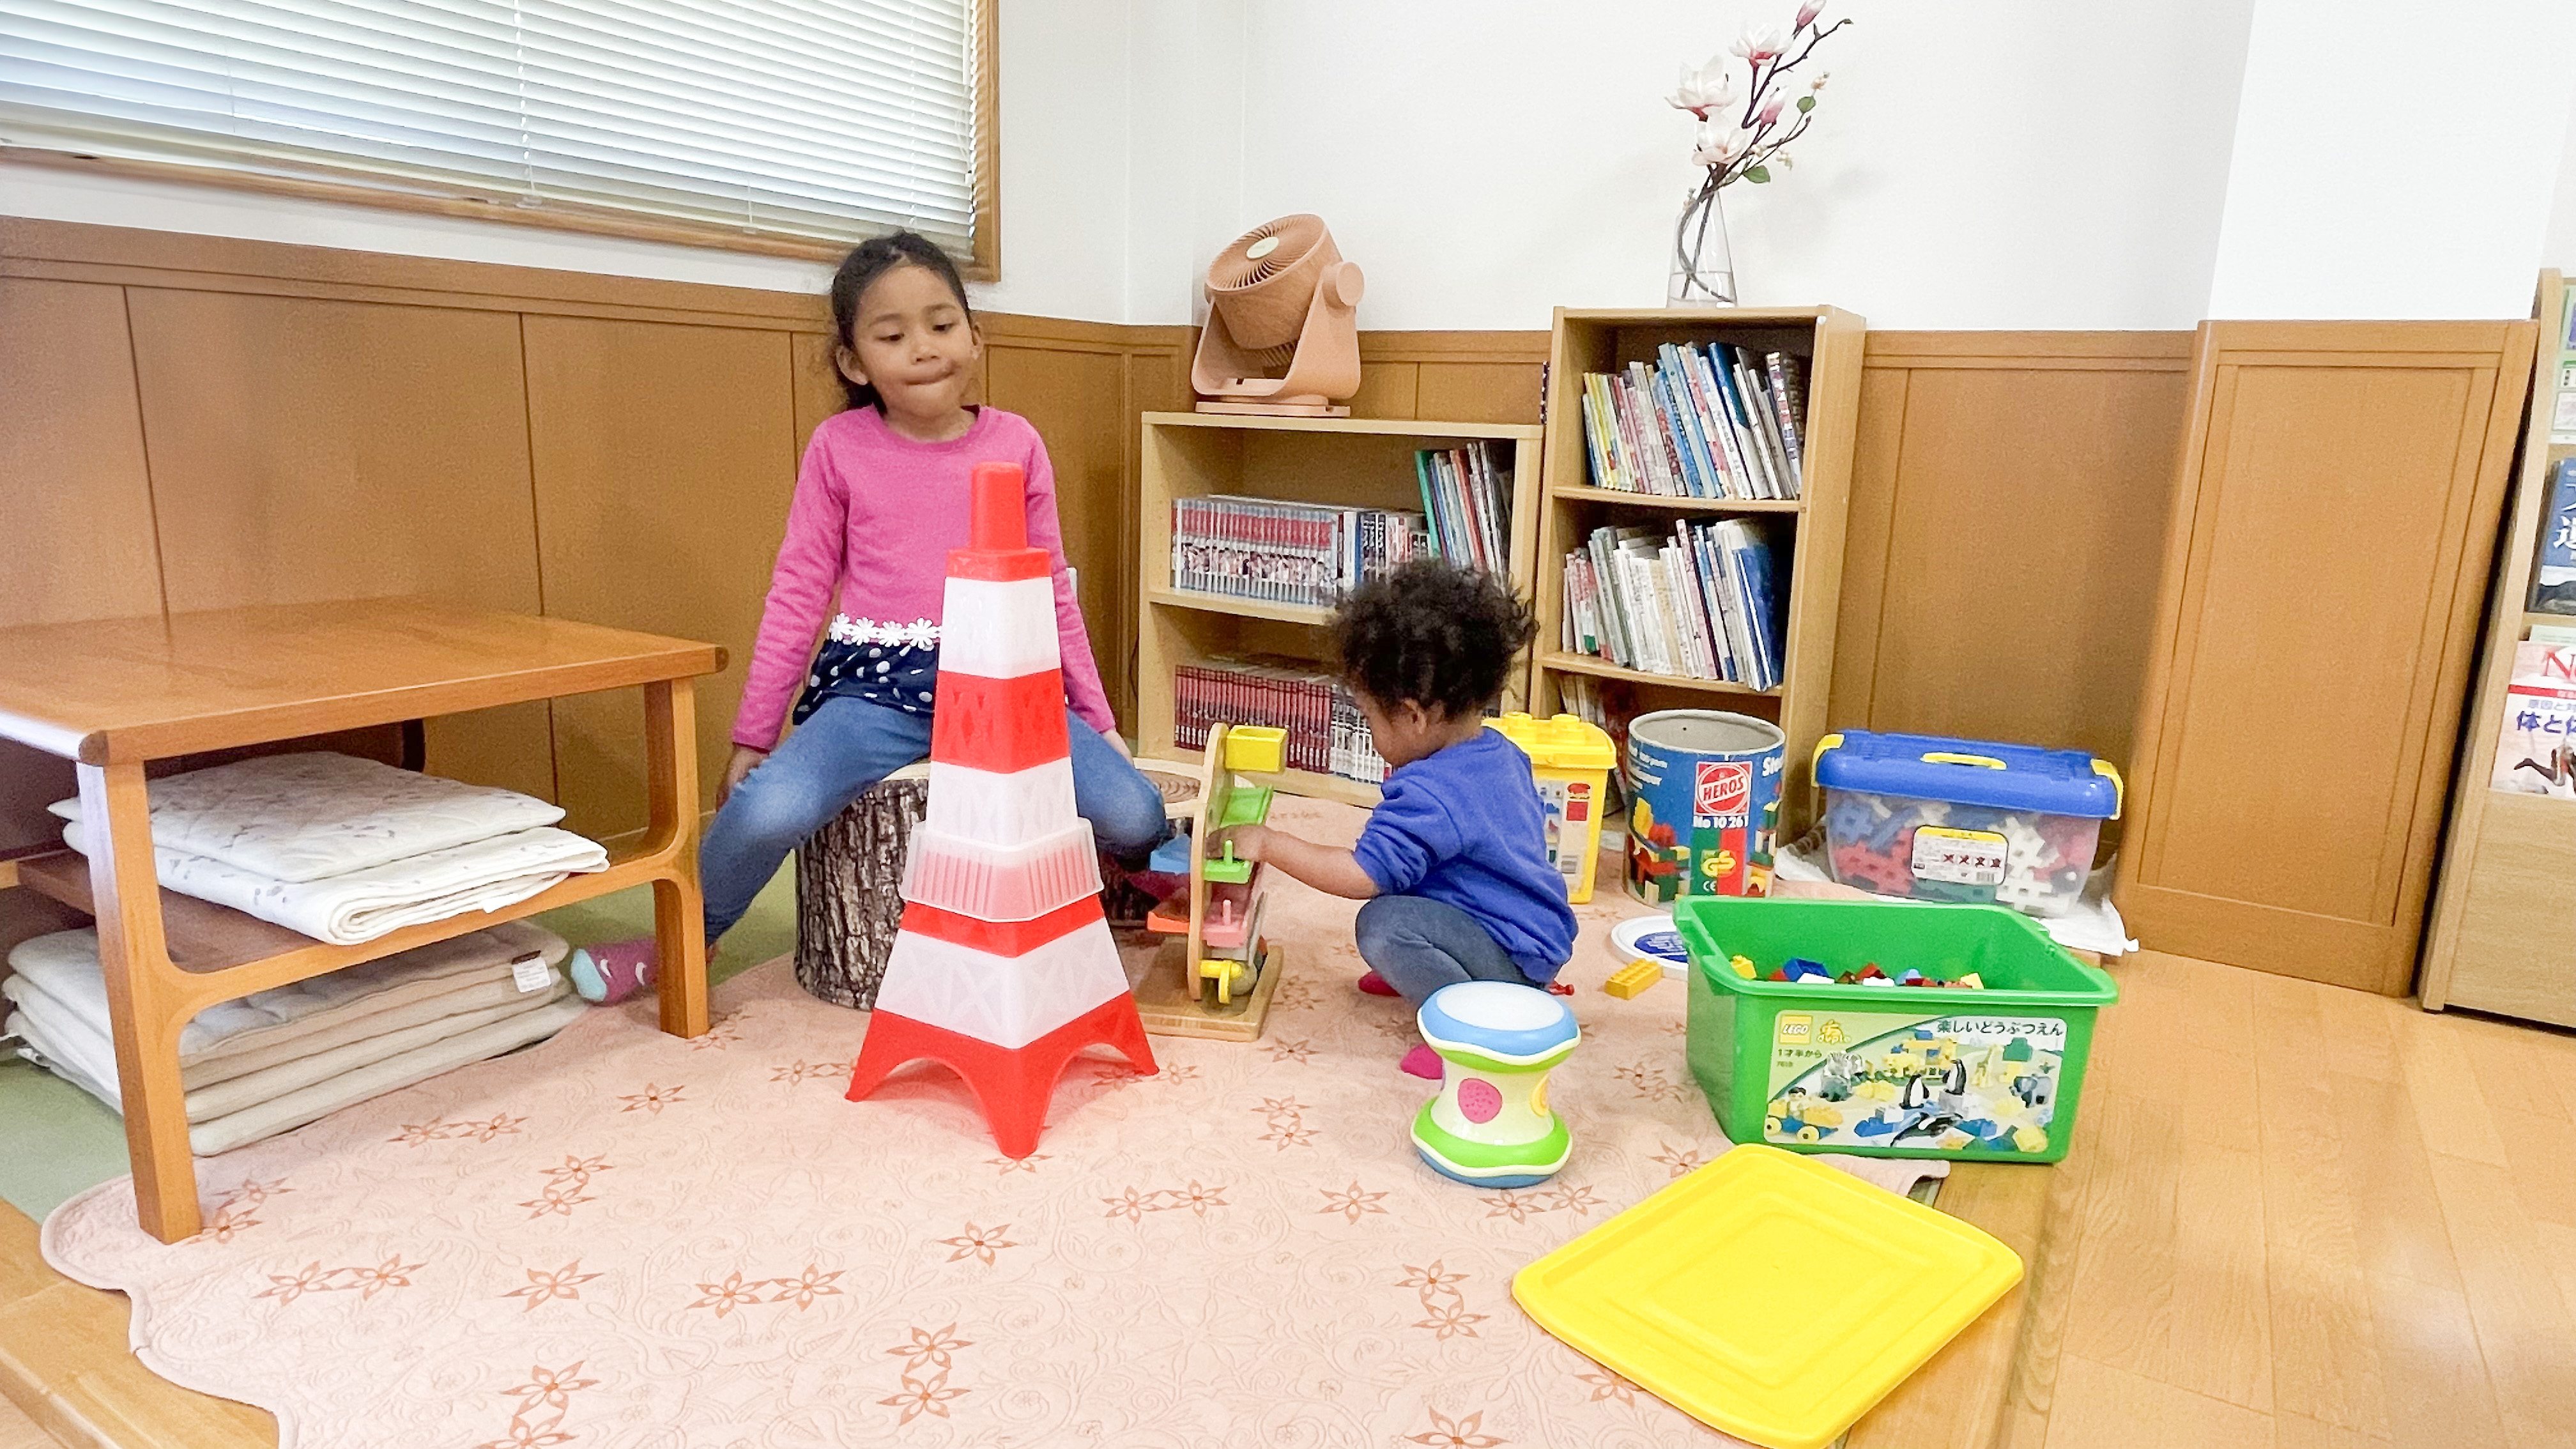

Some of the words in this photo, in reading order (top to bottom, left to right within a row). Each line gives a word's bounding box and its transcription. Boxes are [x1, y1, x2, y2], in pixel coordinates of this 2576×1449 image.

[2540, 651, 2576, 678] N
[1703, 776, 1744, 801] HEROS
[1782, 1024, 1809, 1036] LEGO
[1937, 1020, 2063, 1036] 楽しいどうぶつえん
[1817, 1034, 1851, 1045] duplo
